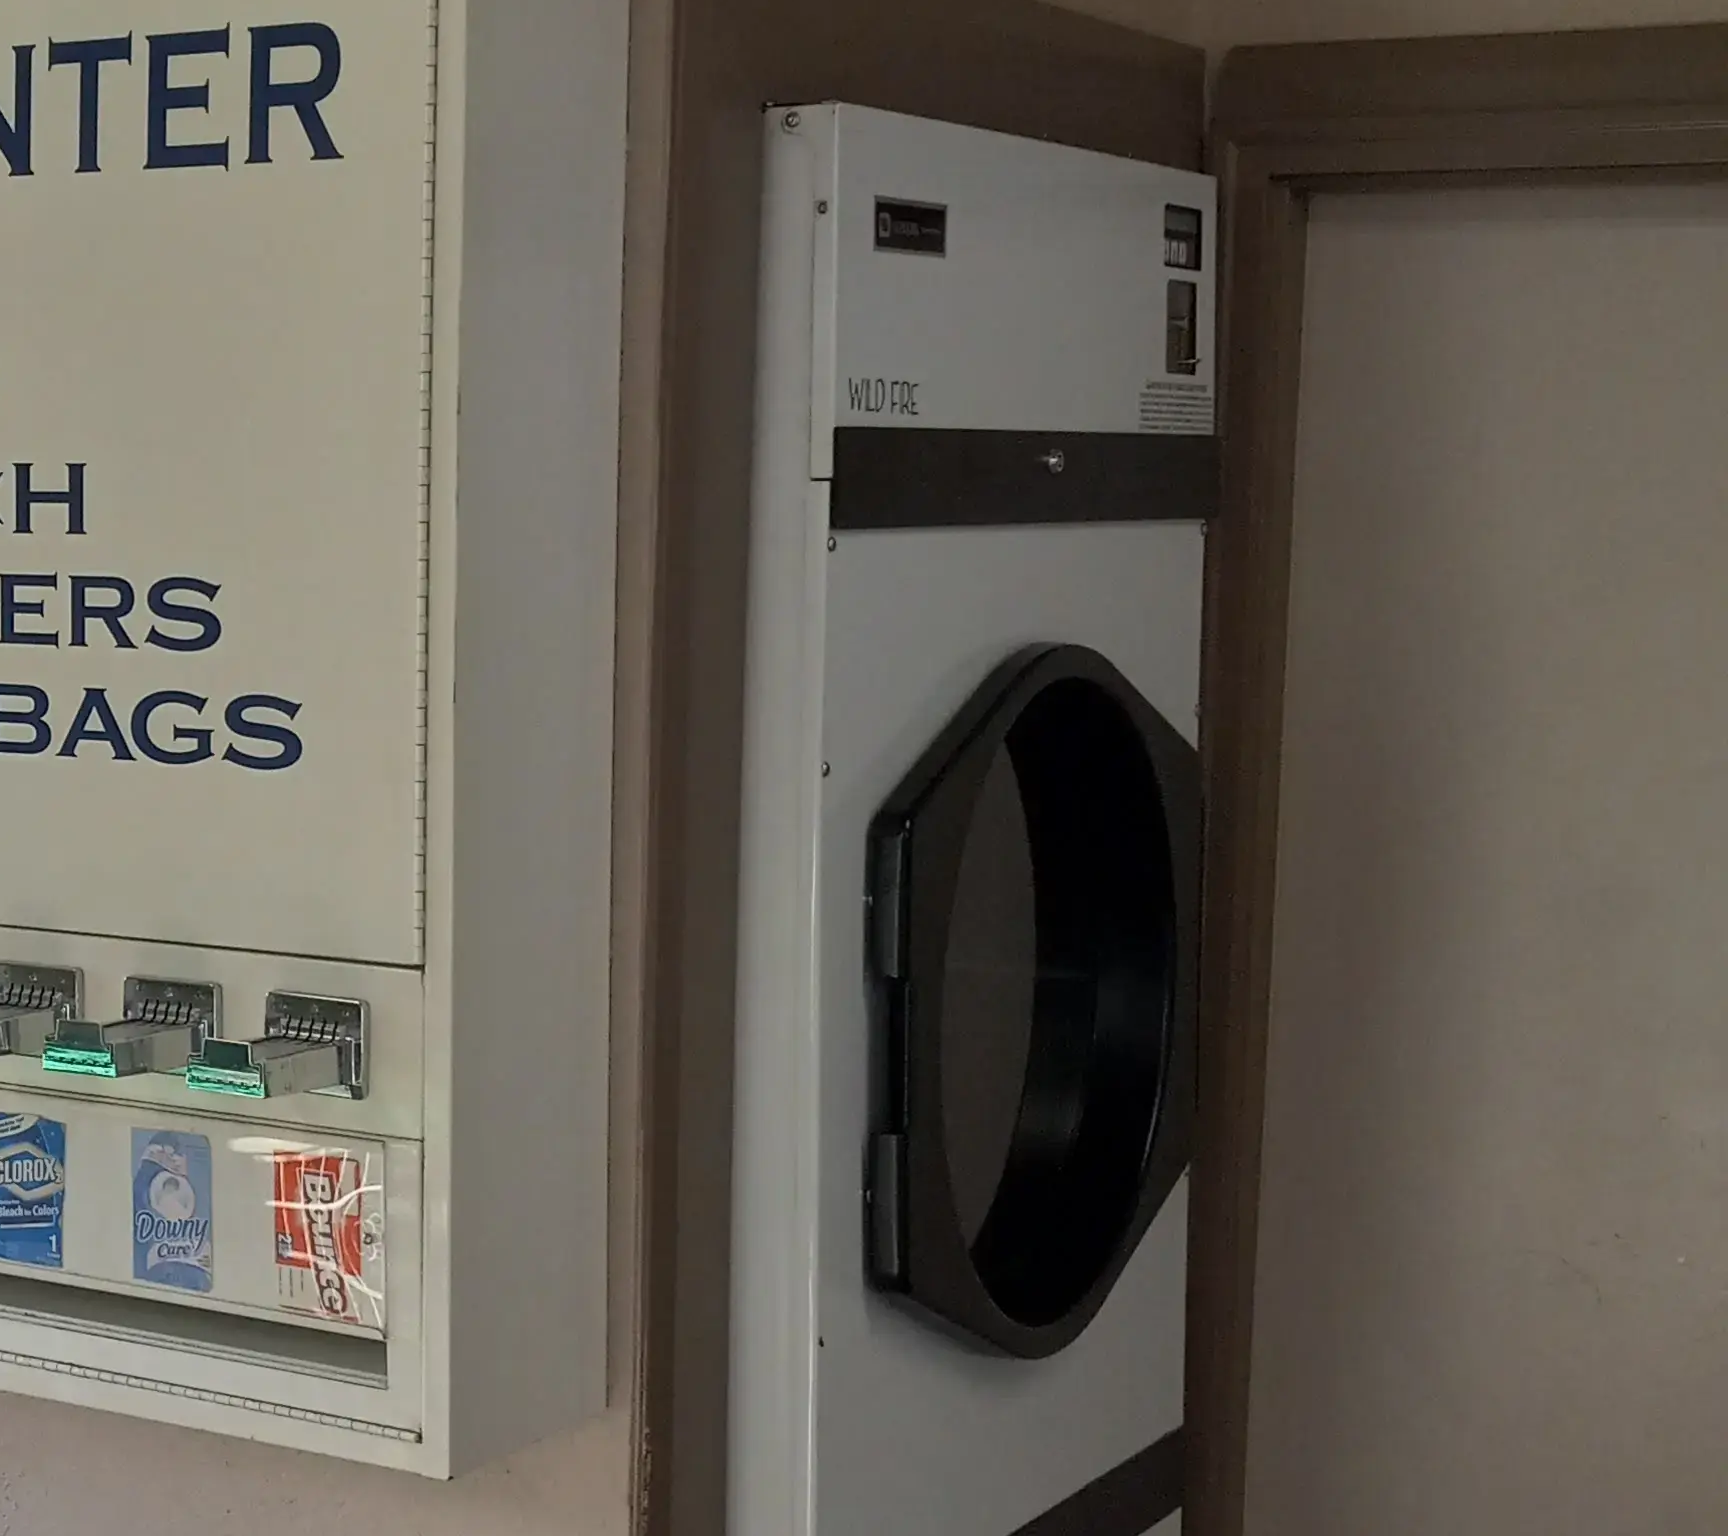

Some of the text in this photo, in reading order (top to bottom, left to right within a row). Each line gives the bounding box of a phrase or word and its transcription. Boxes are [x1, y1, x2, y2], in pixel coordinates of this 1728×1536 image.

[32, 1204, 60, 1216] Colors
[136, 1212, 209, 1252] Downy
[48, 1233, 57, 1253] 1
[157, 1242, 192, 1258] Care
